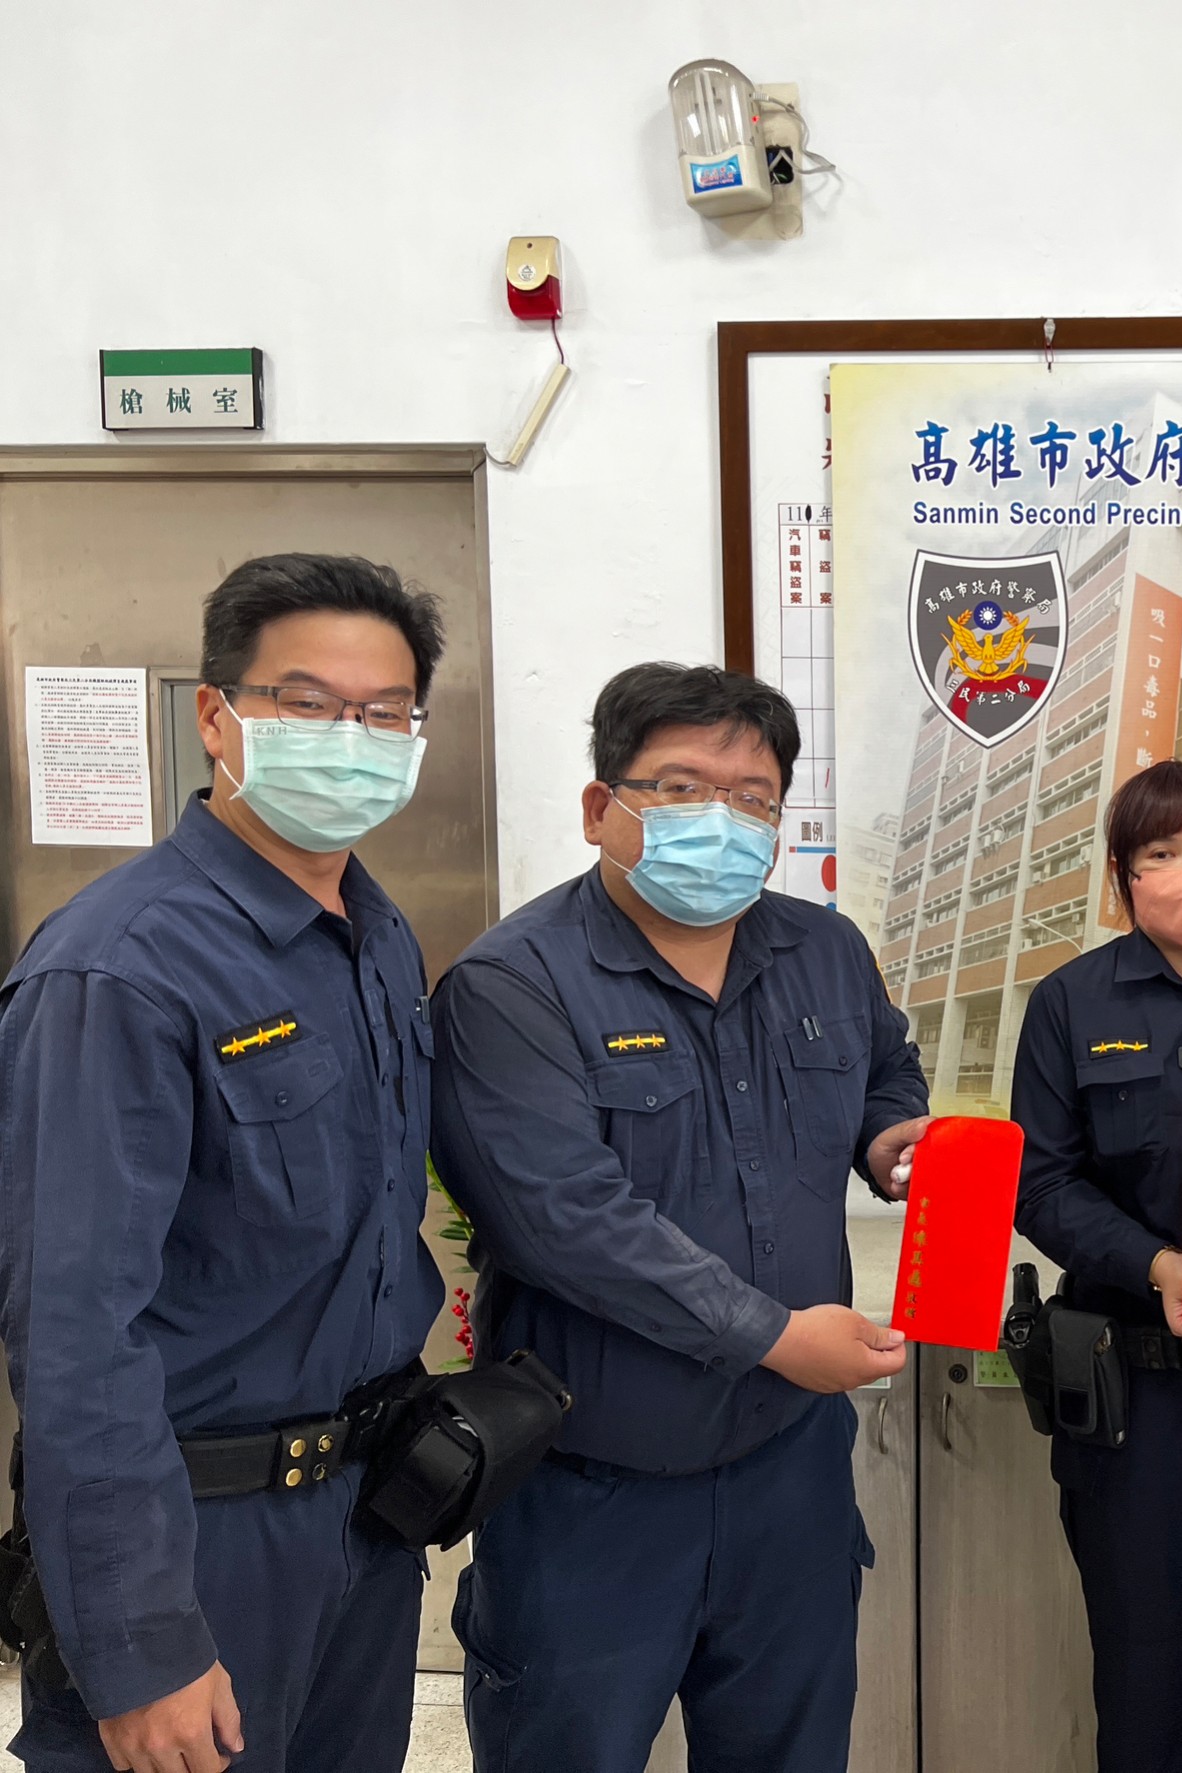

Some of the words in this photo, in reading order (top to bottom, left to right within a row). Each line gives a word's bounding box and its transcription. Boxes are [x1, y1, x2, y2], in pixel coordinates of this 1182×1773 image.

[119, 387, 239, 415] 槍械室
[913, 501, 998, 524] Sanmin
[1010, 501, 1096, 525] Second
[788, 528, 803, 605] 汽車竊盜案
[924, 578, 1053, 614] 高雄市政府警察局
[946, 679, 1031, 706] 三民第二分局
